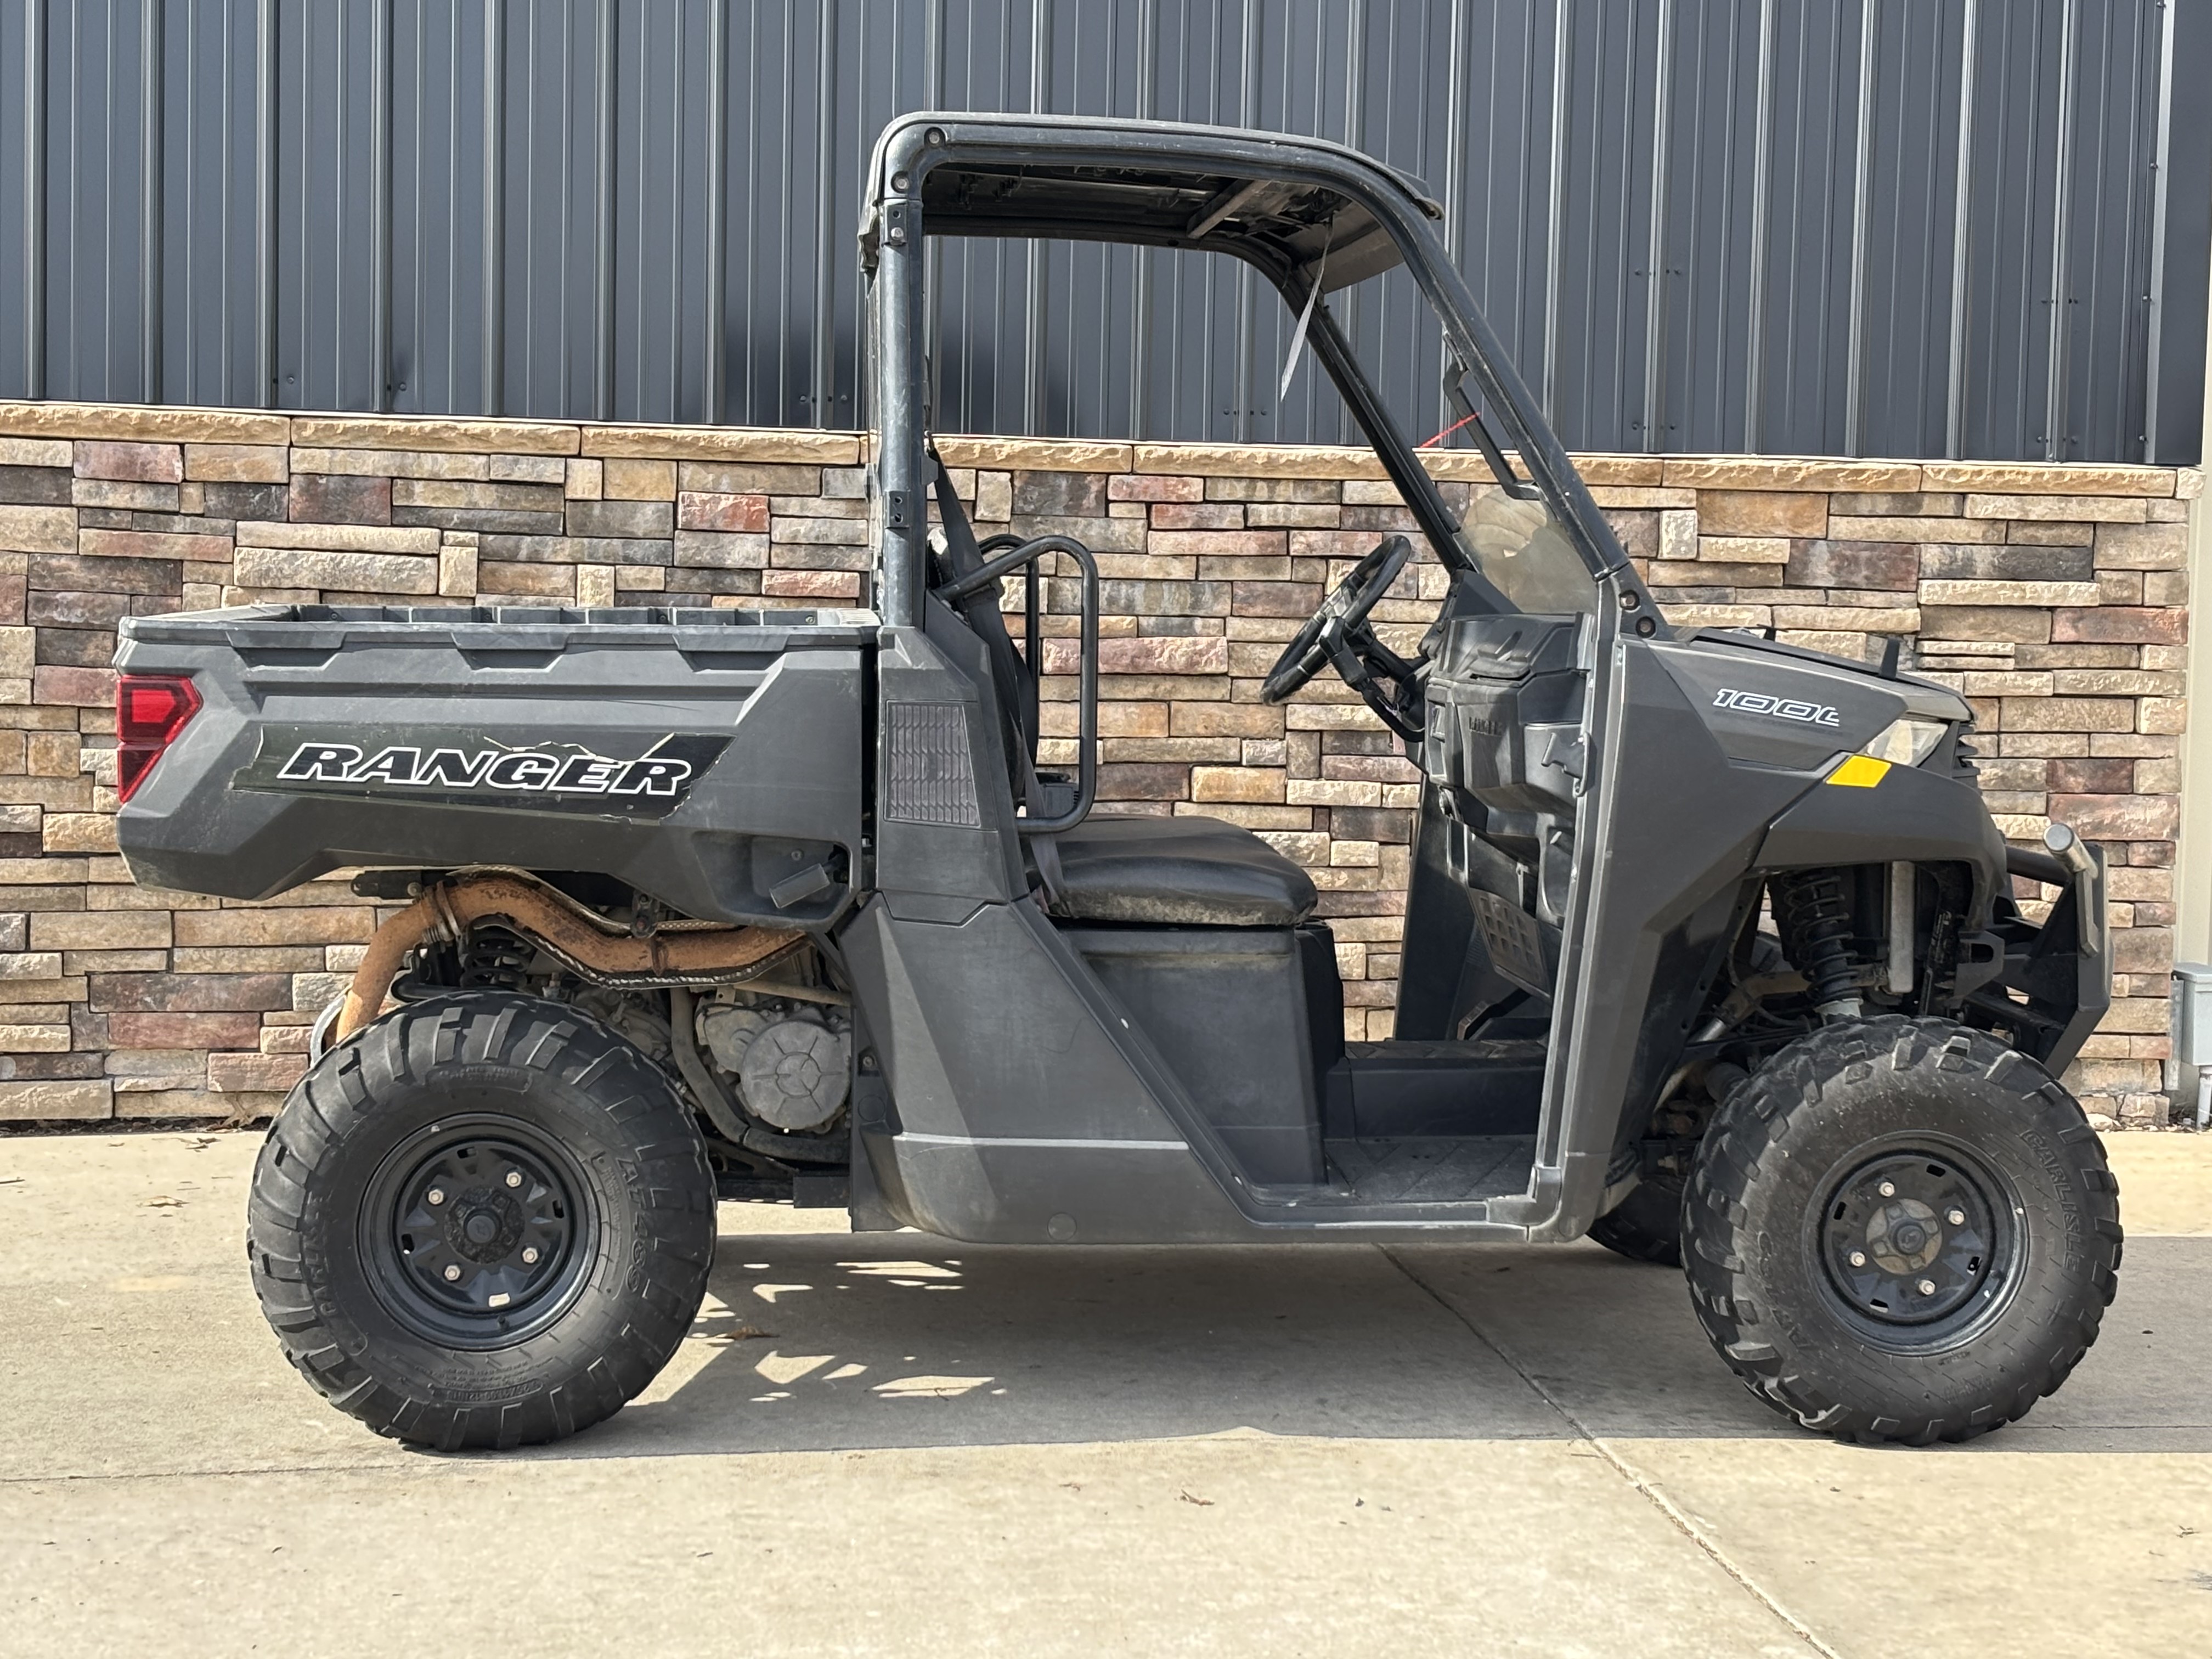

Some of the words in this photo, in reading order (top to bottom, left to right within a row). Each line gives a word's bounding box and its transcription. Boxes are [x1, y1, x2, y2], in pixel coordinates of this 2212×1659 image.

[276, 742, 692, 796] RANGER
[615, 1158, 647, 1293] AT489
[2019, 1129, 2081, 1271] CARLISLE
